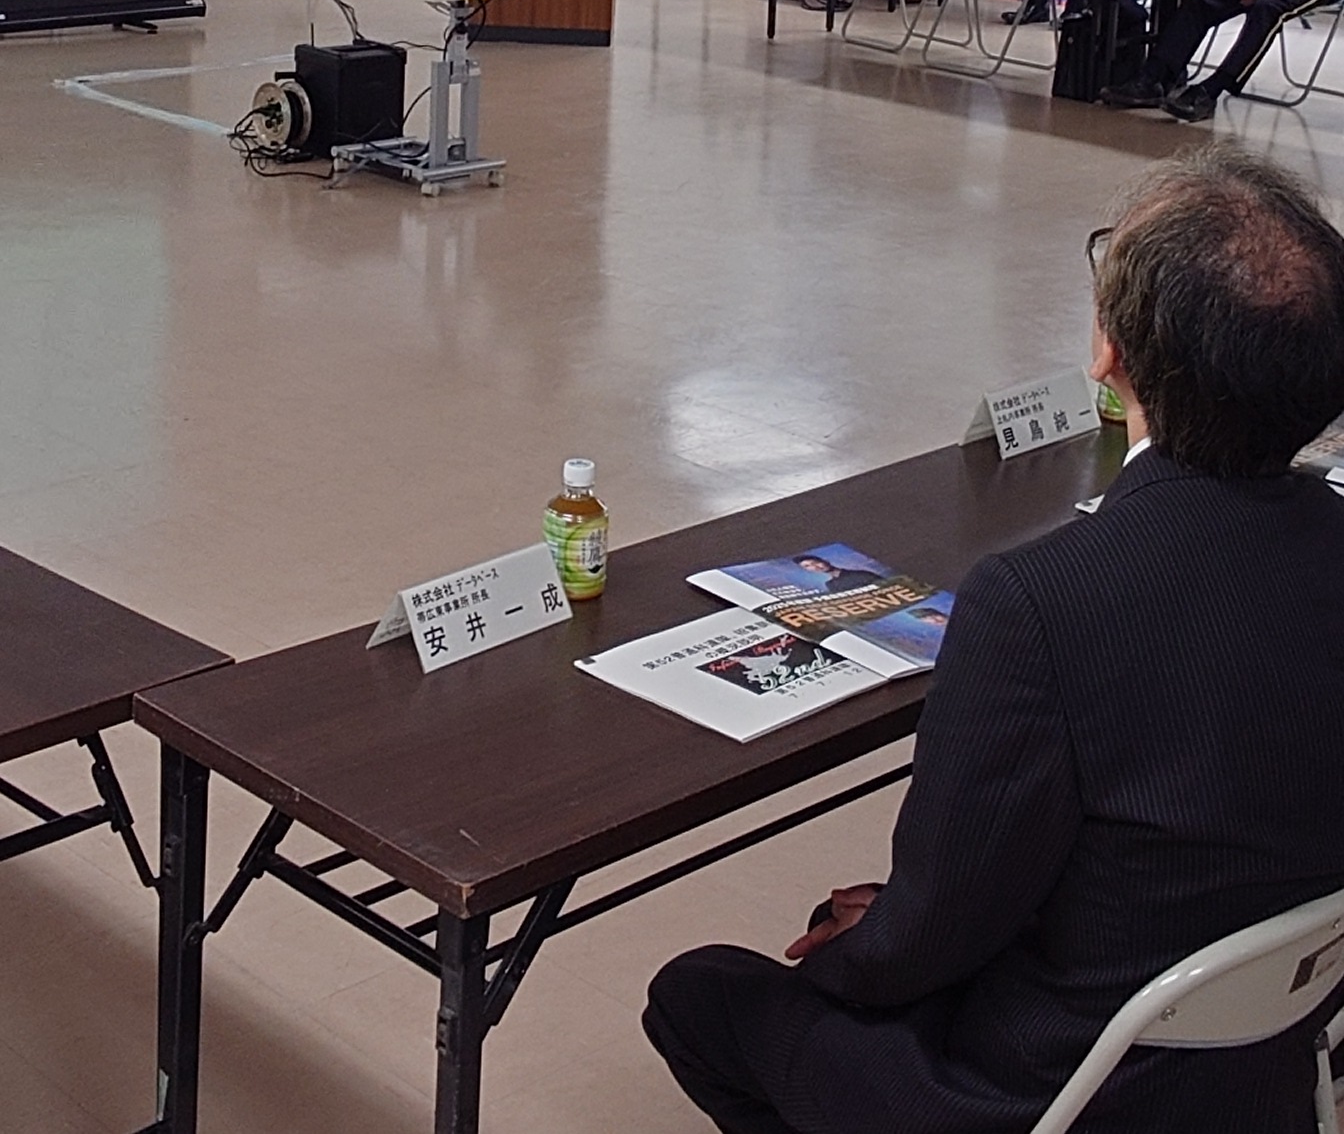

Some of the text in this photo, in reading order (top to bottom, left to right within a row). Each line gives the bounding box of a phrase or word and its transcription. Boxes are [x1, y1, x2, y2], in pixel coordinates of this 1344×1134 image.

[993, 396, 1021, 412] 株式会社
[412, 584, 455, 607] 株式会社
[417, 588, 490, 623] 帯広東事業所 所長
[779, 589, 924, 627] RESERVE
